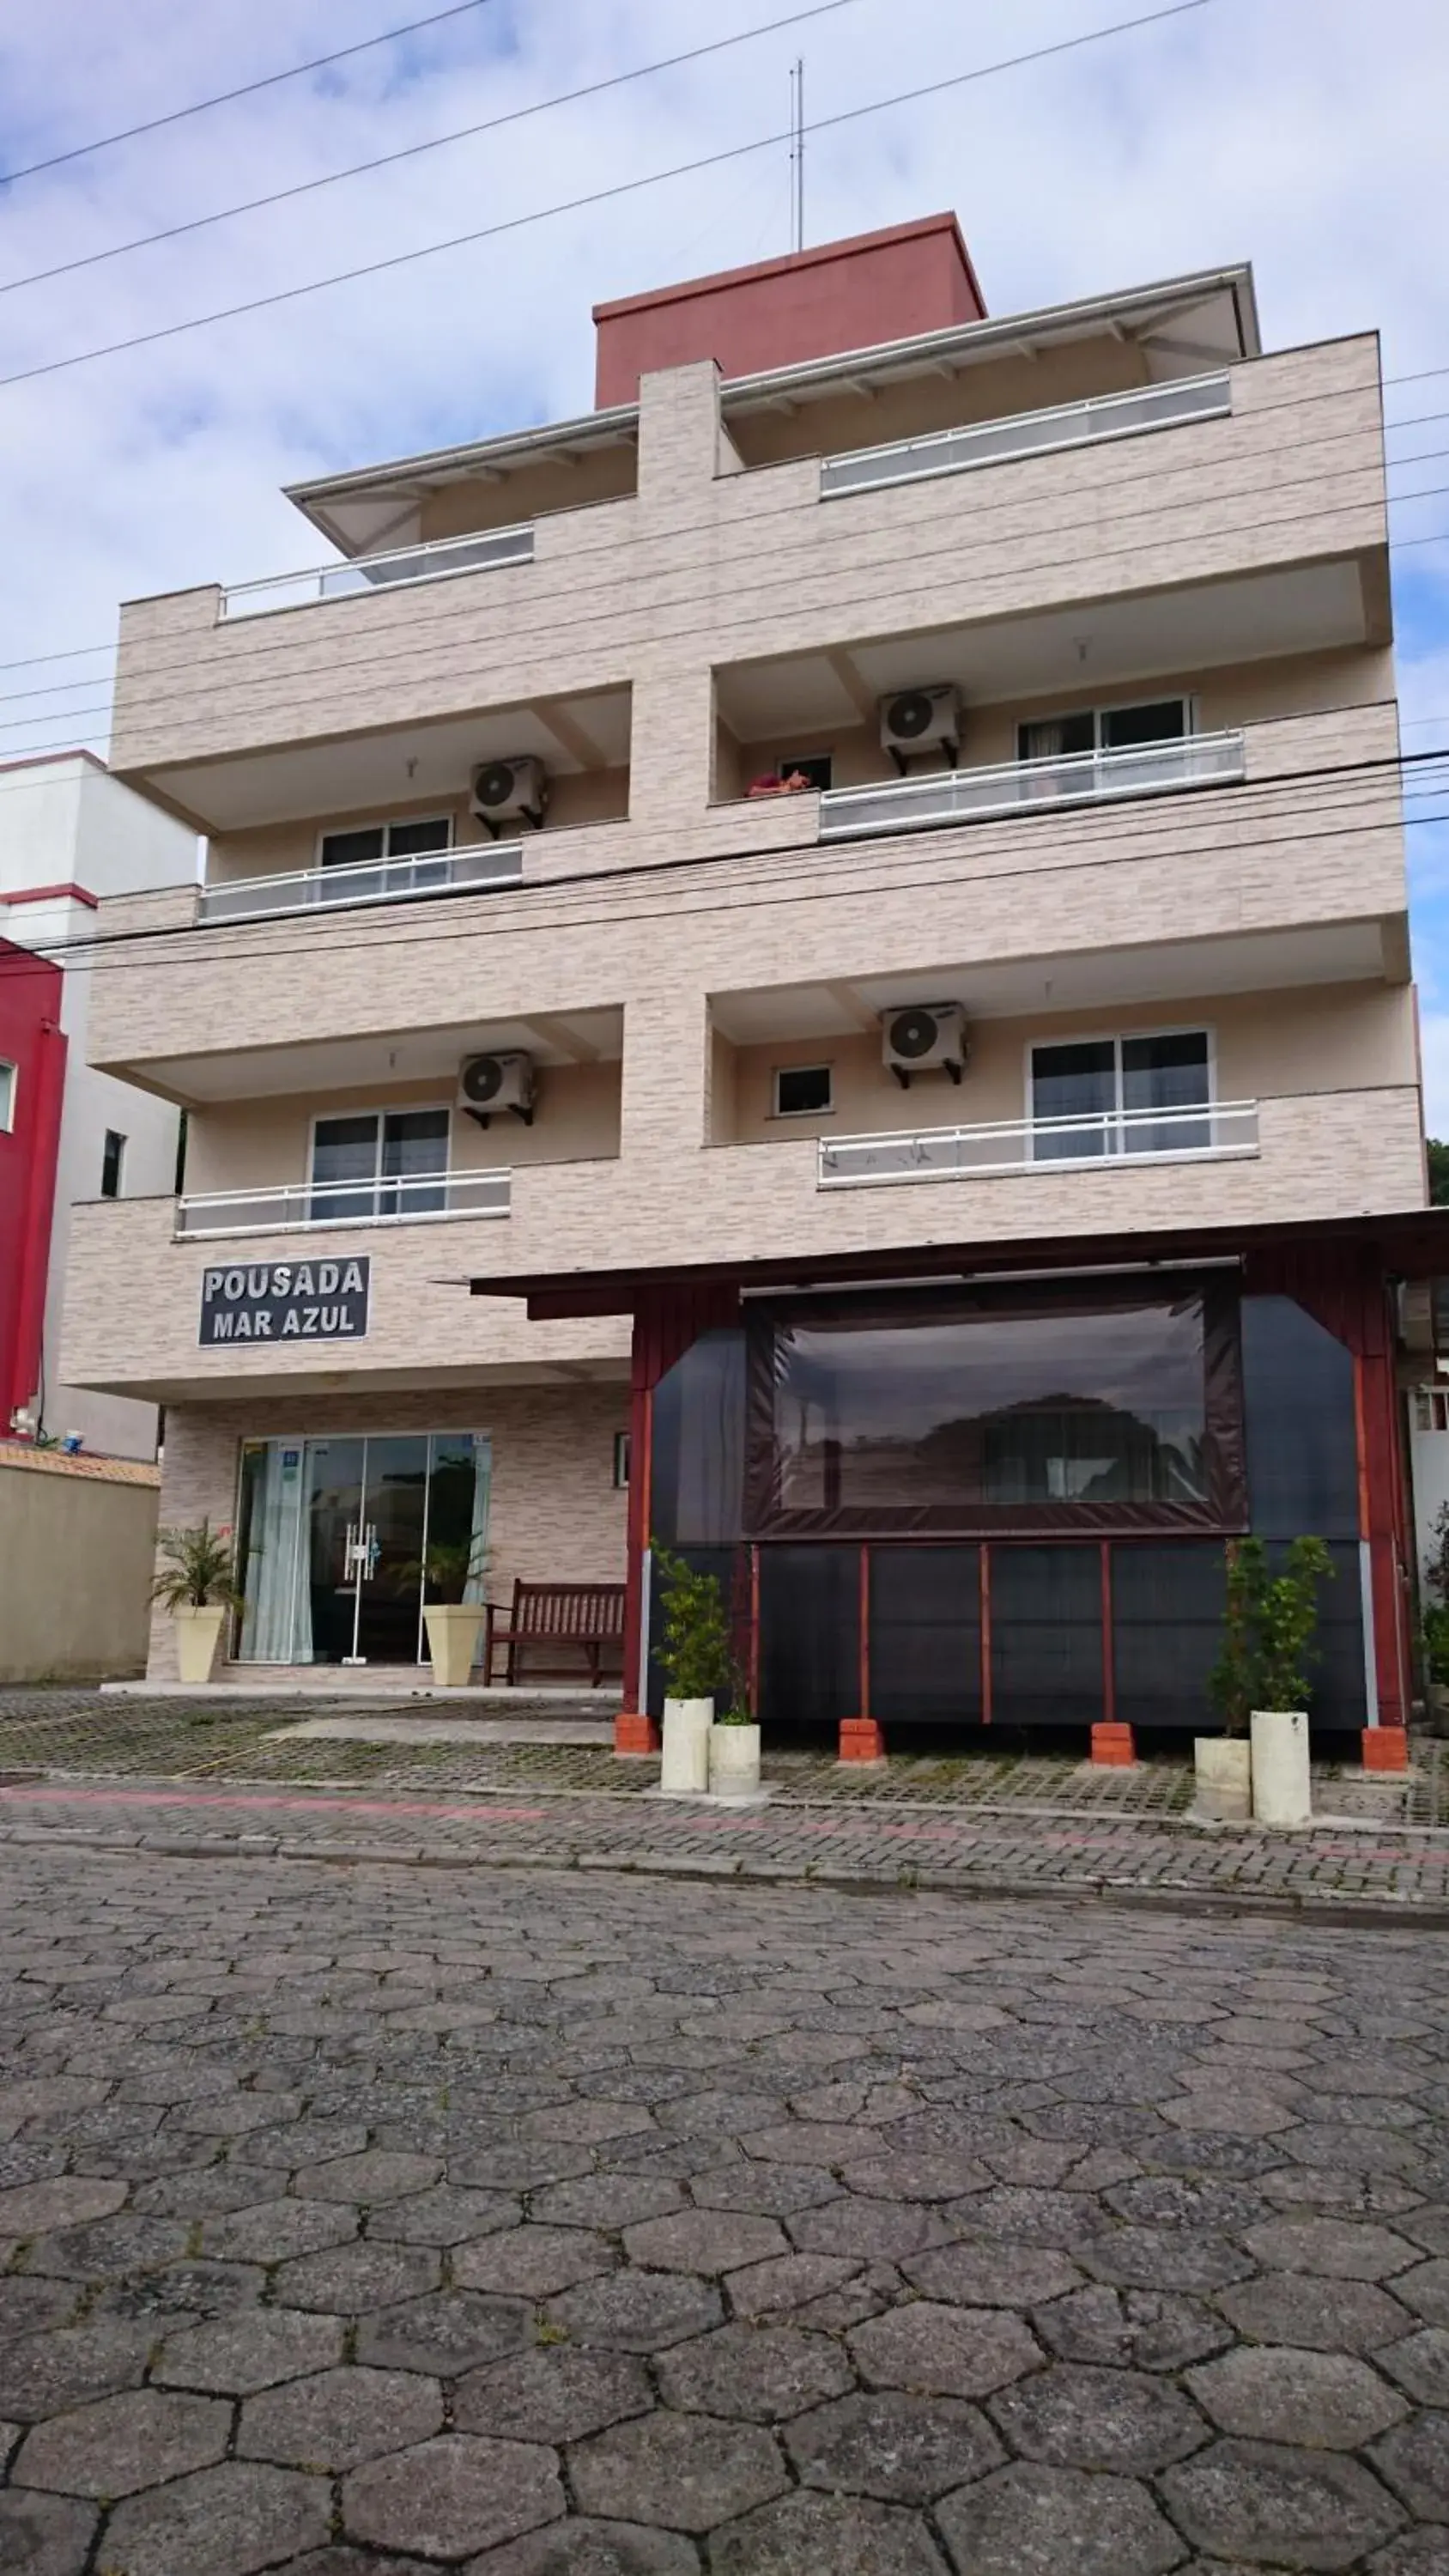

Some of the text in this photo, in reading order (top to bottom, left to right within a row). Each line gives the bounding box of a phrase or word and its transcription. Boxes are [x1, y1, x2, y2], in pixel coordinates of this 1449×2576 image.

[205, 1261, 364, 1302] POUSADA
[213, 1305, 355, 1339] MAR AZUL
